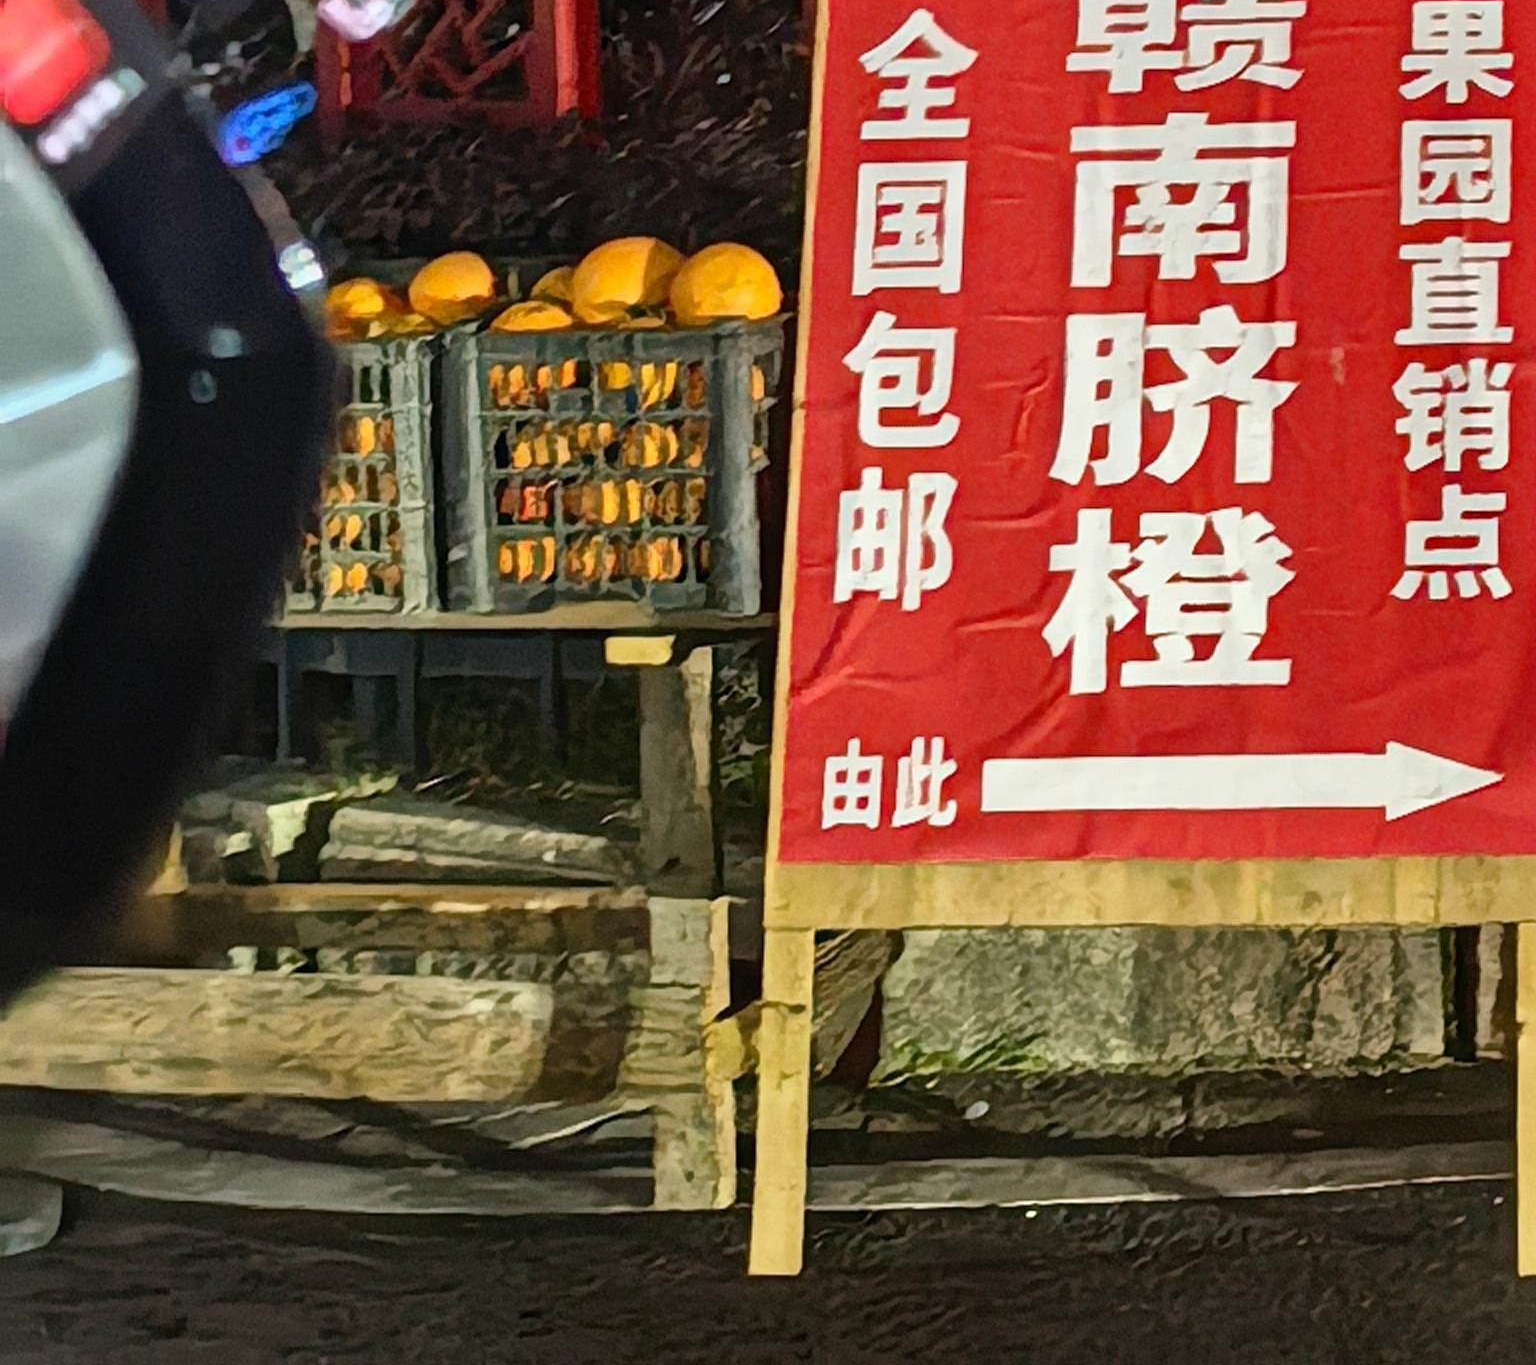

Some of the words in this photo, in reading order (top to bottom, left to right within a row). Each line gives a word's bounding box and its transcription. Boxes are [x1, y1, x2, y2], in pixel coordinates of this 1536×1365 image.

[833, 8, 979, 611] 全国包邮
[1392, 0, 1514, 601] 果园直销点
[820, 735, 959, 831] 由此
